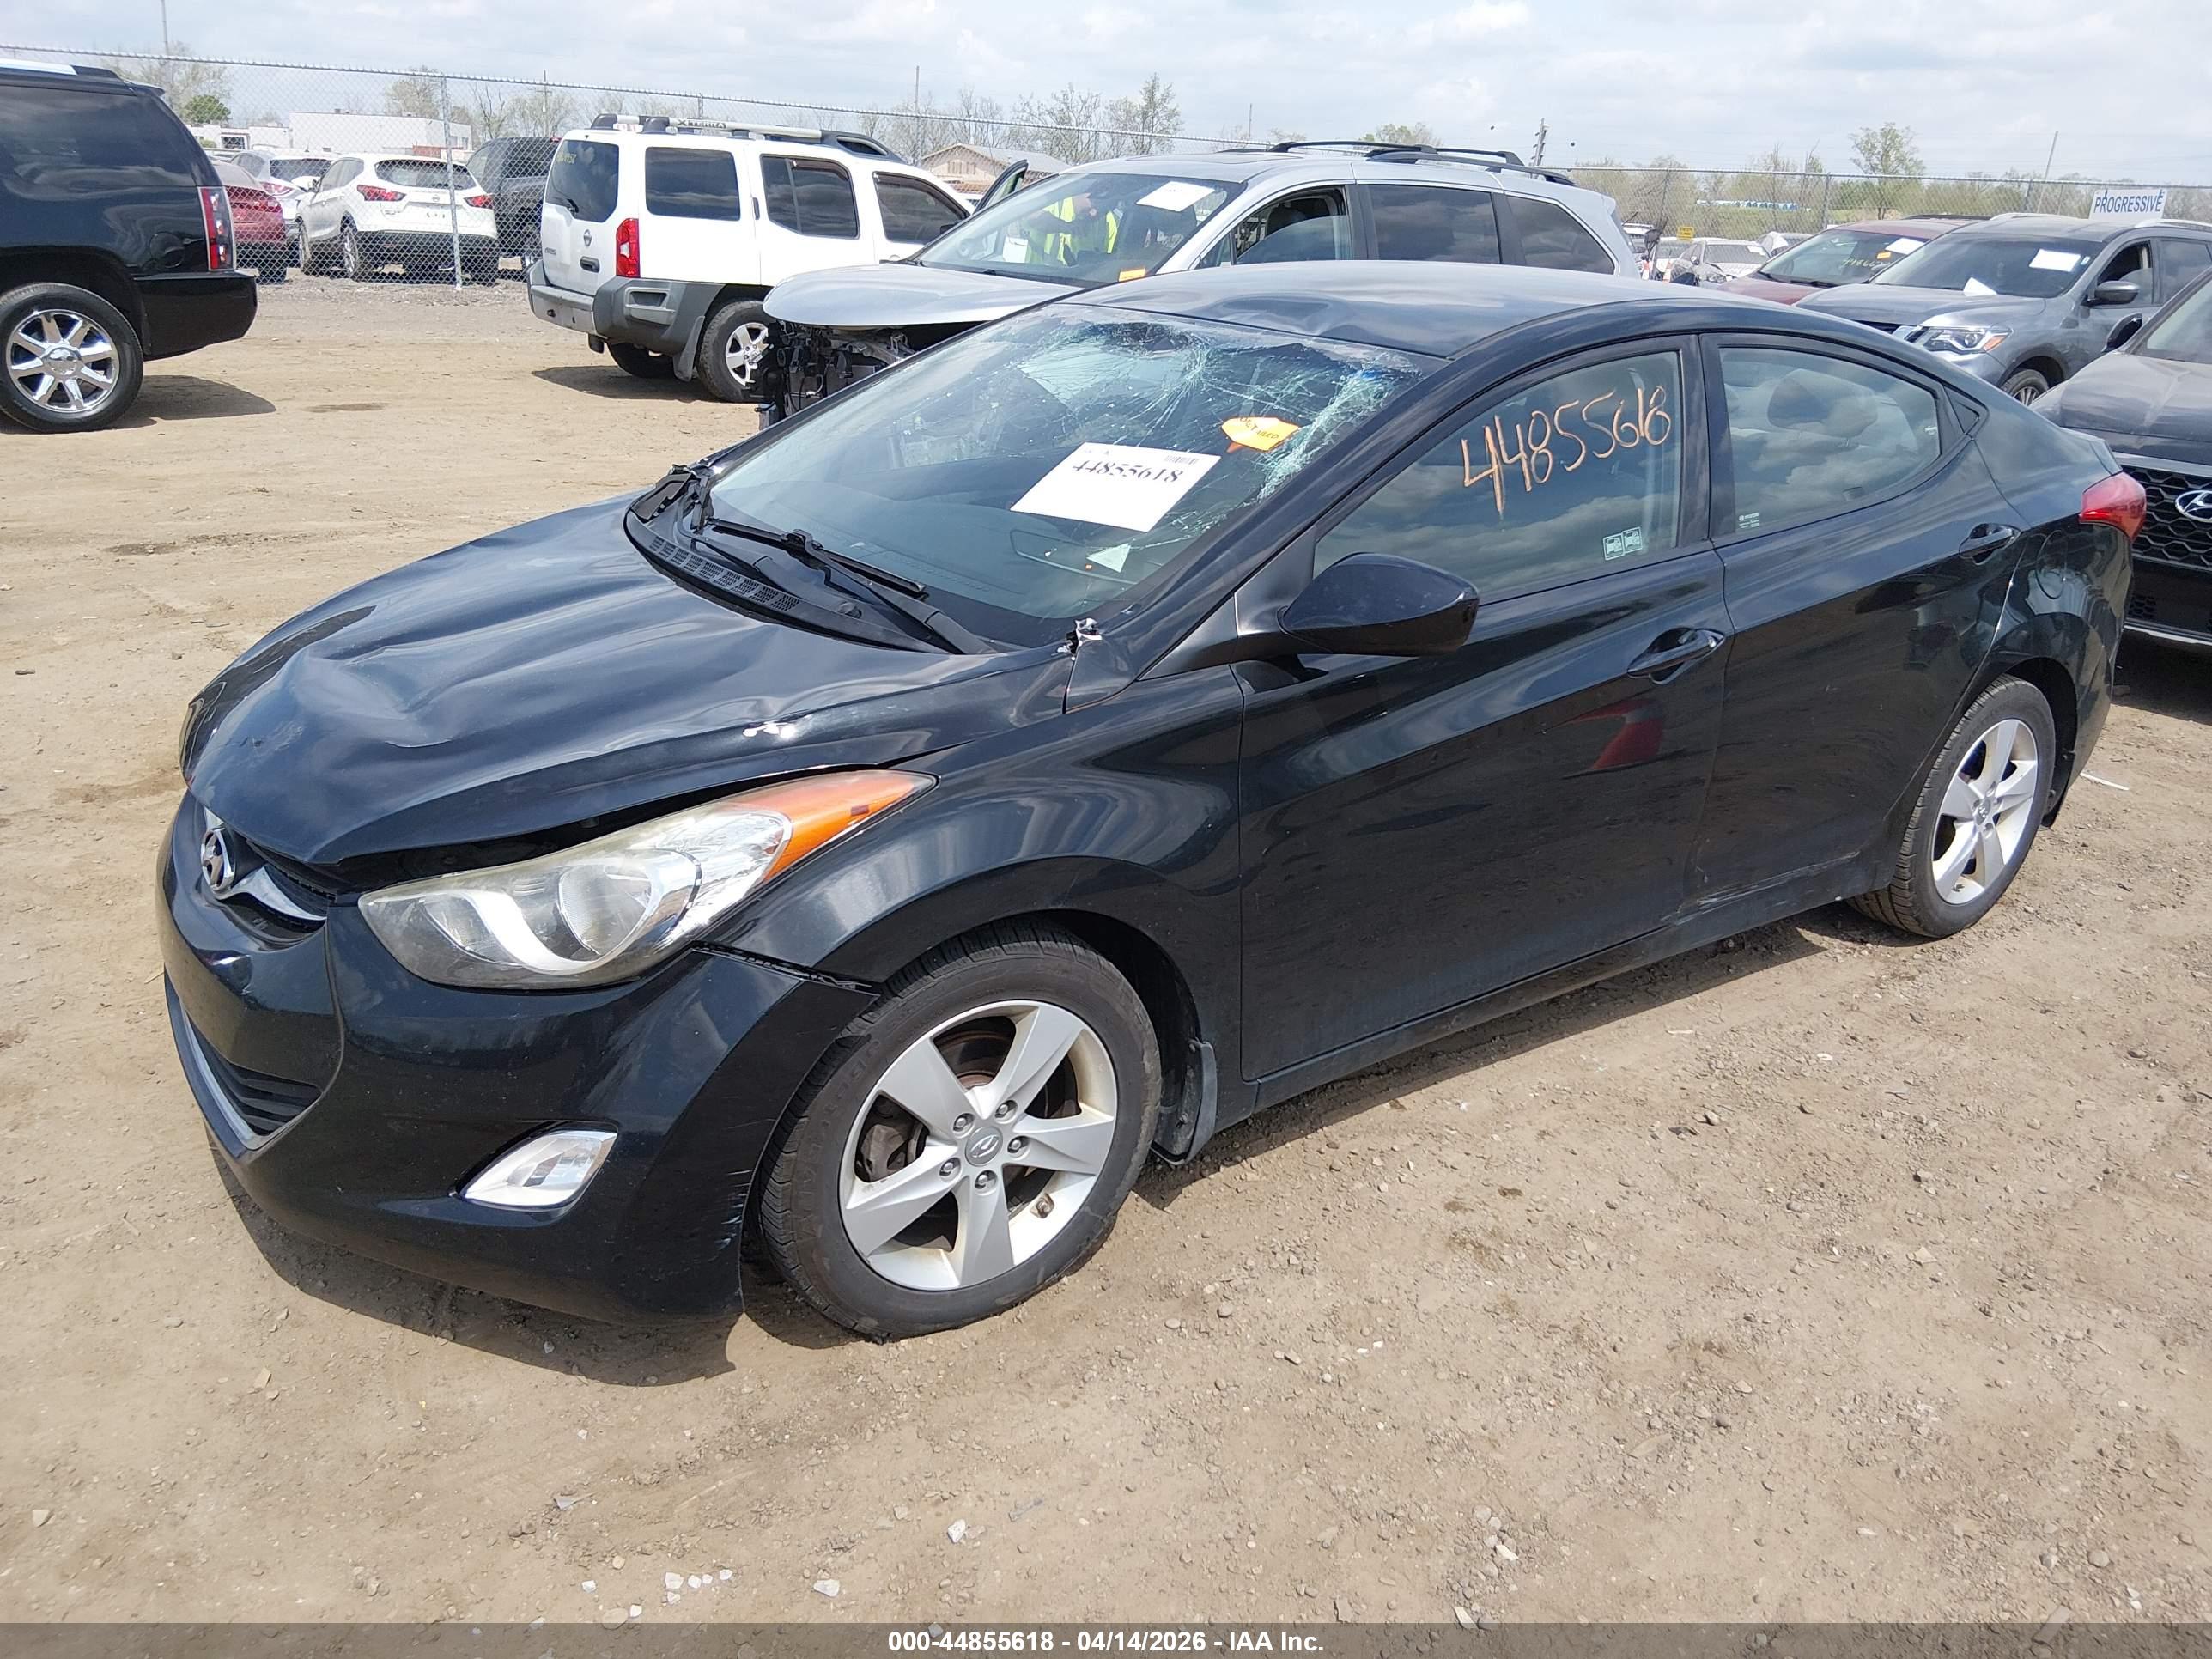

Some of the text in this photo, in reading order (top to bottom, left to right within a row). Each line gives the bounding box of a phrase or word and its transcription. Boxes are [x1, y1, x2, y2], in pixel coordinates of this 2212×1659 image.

[2094, 194, 2164, 214] PROGRESSIVE
[1461, 386, 1672, 517] 44855618
[1072, 459, 1184, 483] 44855618
